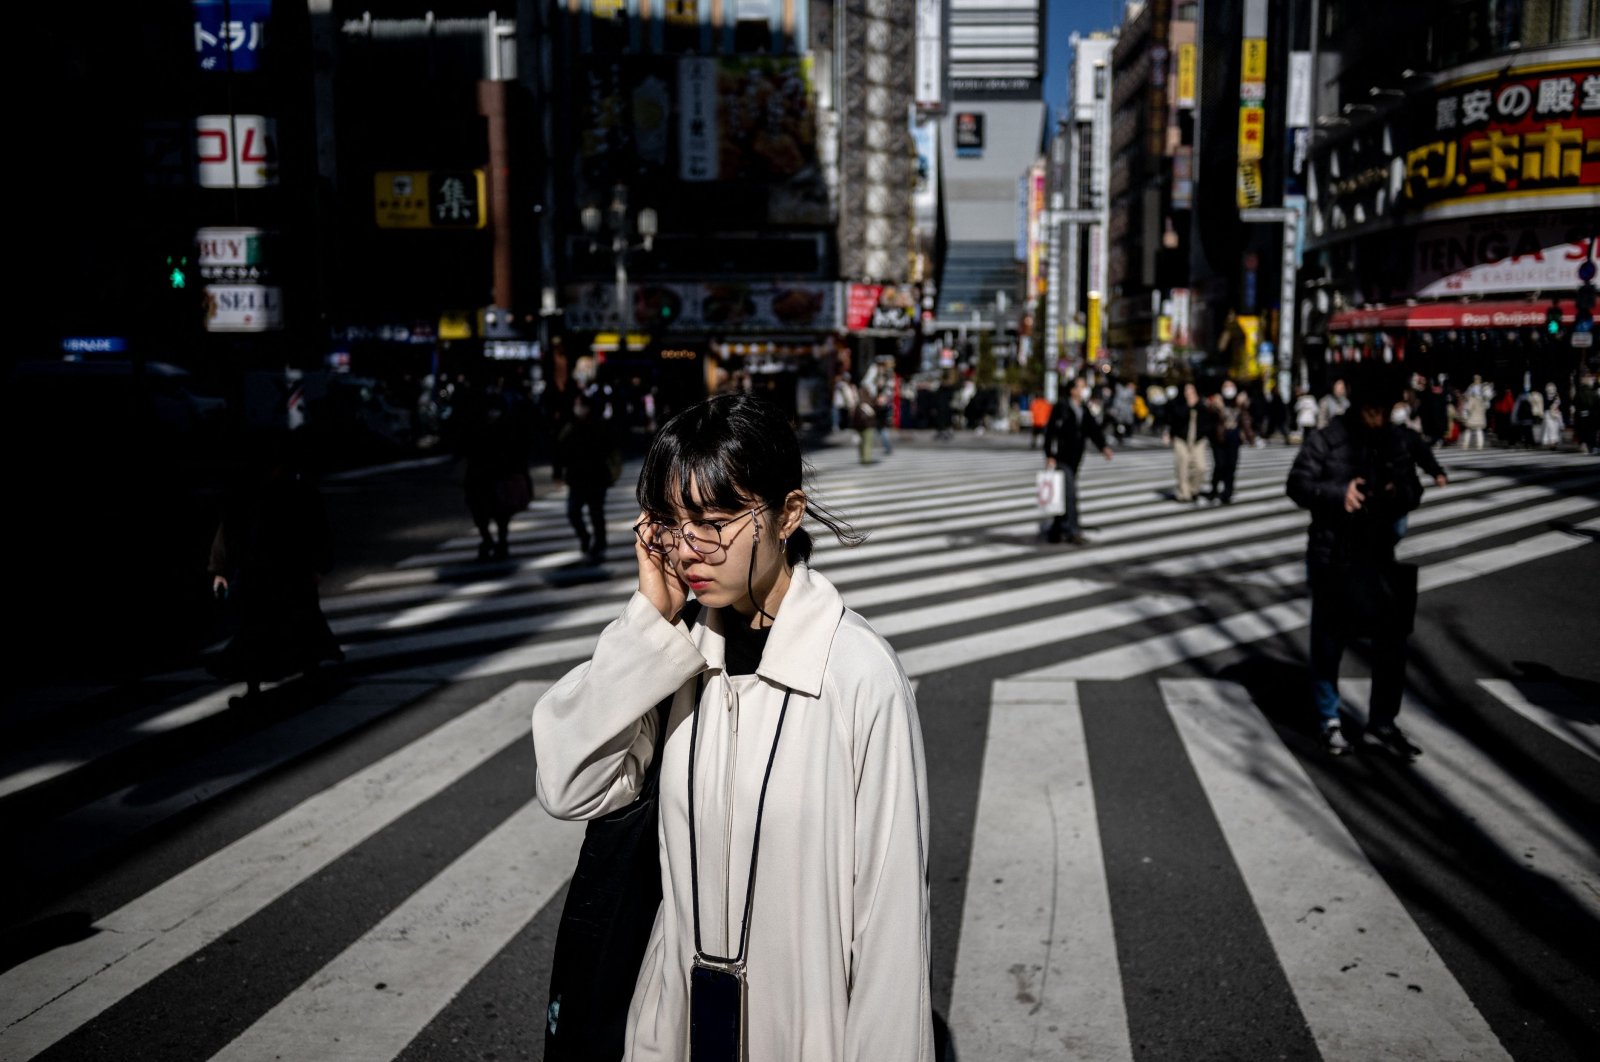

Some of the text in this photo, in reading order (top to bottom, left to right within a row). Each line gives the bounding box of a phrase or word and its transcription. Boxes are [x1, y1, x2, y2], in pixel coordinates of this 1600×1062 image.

[198, 239, 242, 258] BUY
[1420, 230, 1544, 272] TENGA
[219, 291, 277, 312] SELL
